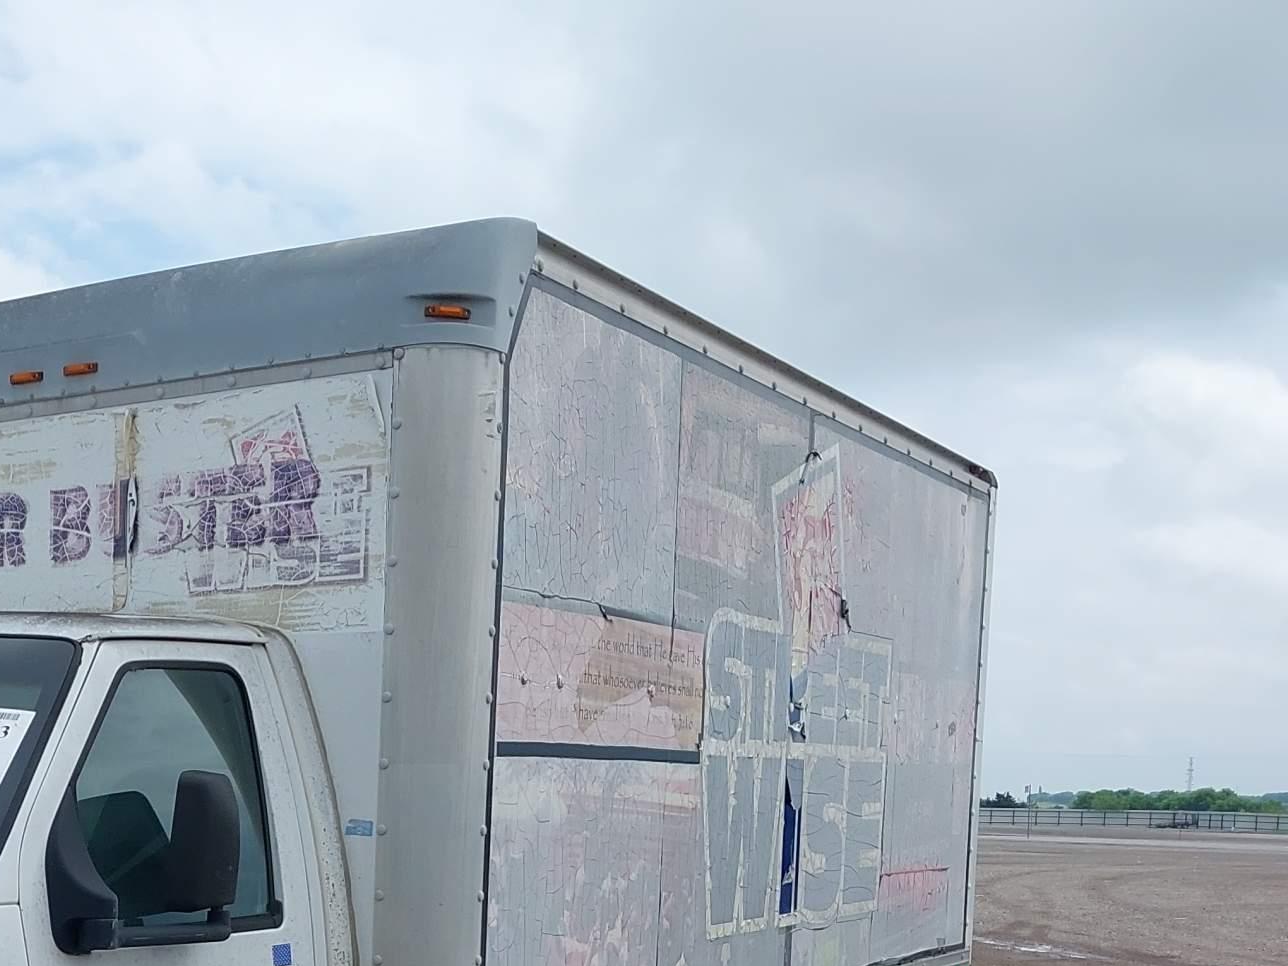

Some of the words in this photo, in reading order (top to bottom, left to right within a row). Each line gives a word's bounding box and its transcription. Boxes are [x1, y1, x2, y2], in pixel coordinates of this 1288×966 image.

[613, 632, 635, 655] world
[636, 640, 652, 659] that
[602, 664, 645, 690] whosoever
